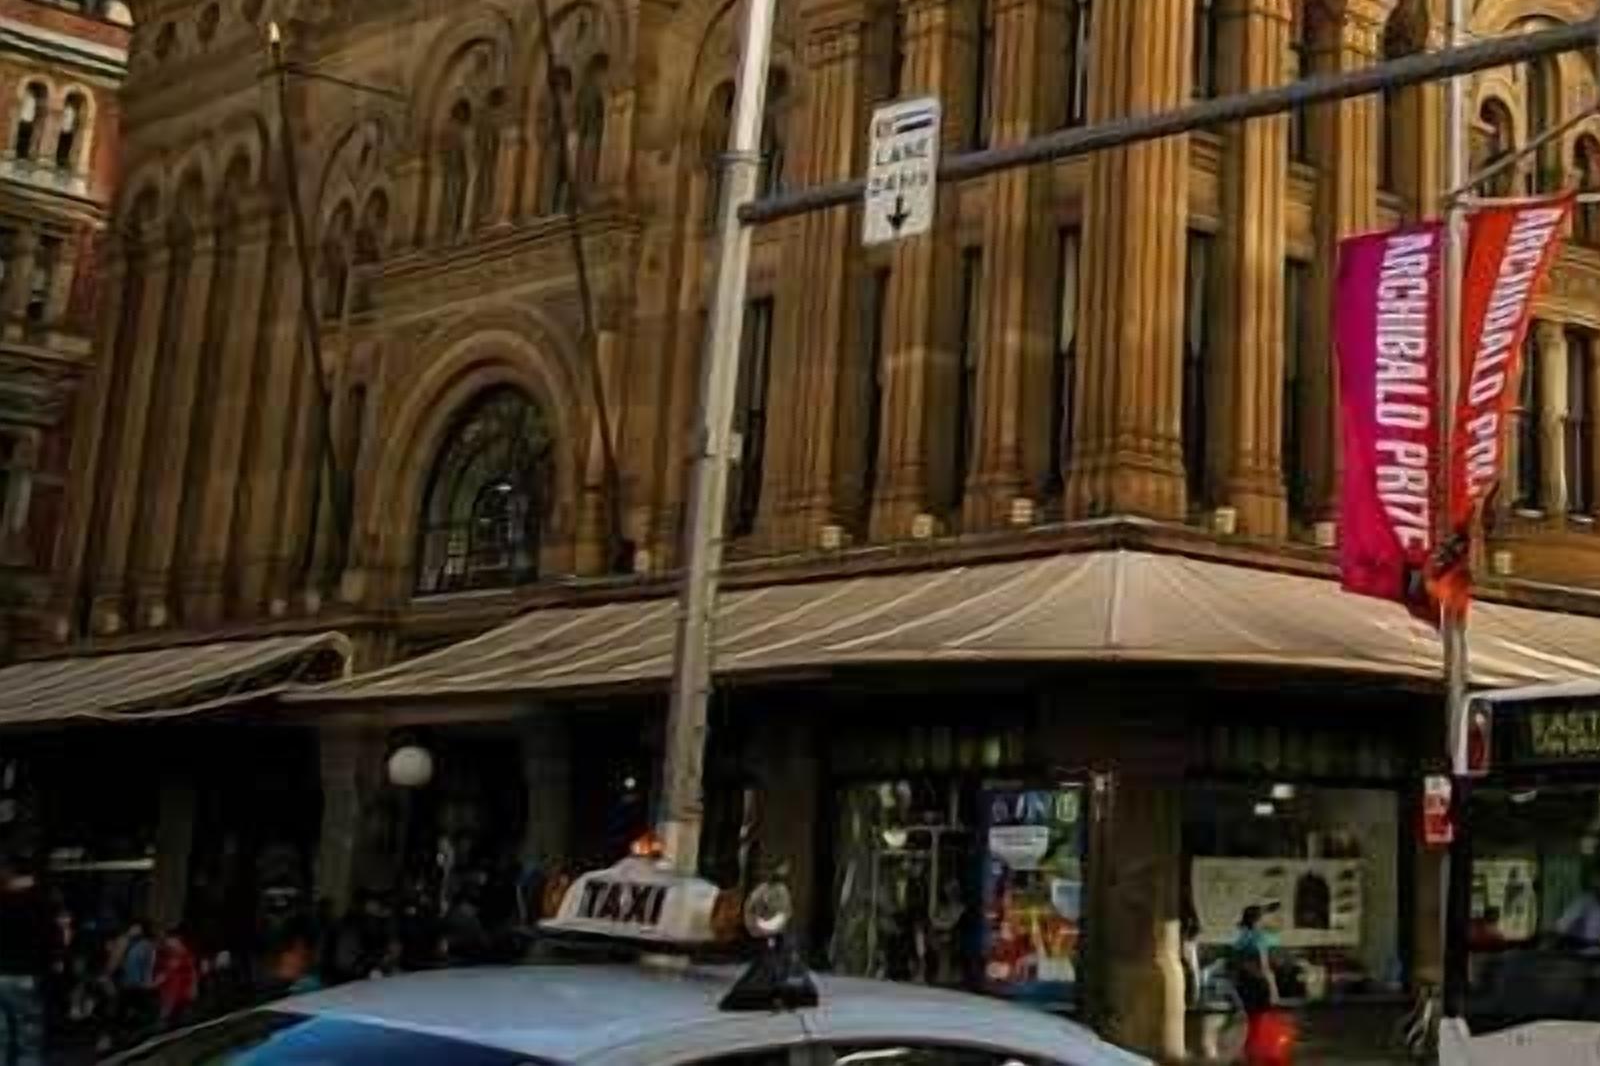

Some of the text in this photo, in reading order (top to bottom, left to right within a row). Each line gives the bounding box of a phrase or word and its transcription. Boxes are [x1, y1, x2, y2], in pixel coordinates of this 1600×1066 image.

[1375, 233, 1434, 551] ARCHIBALD PRIZE
[576, 881, 667, 926] TAXI
